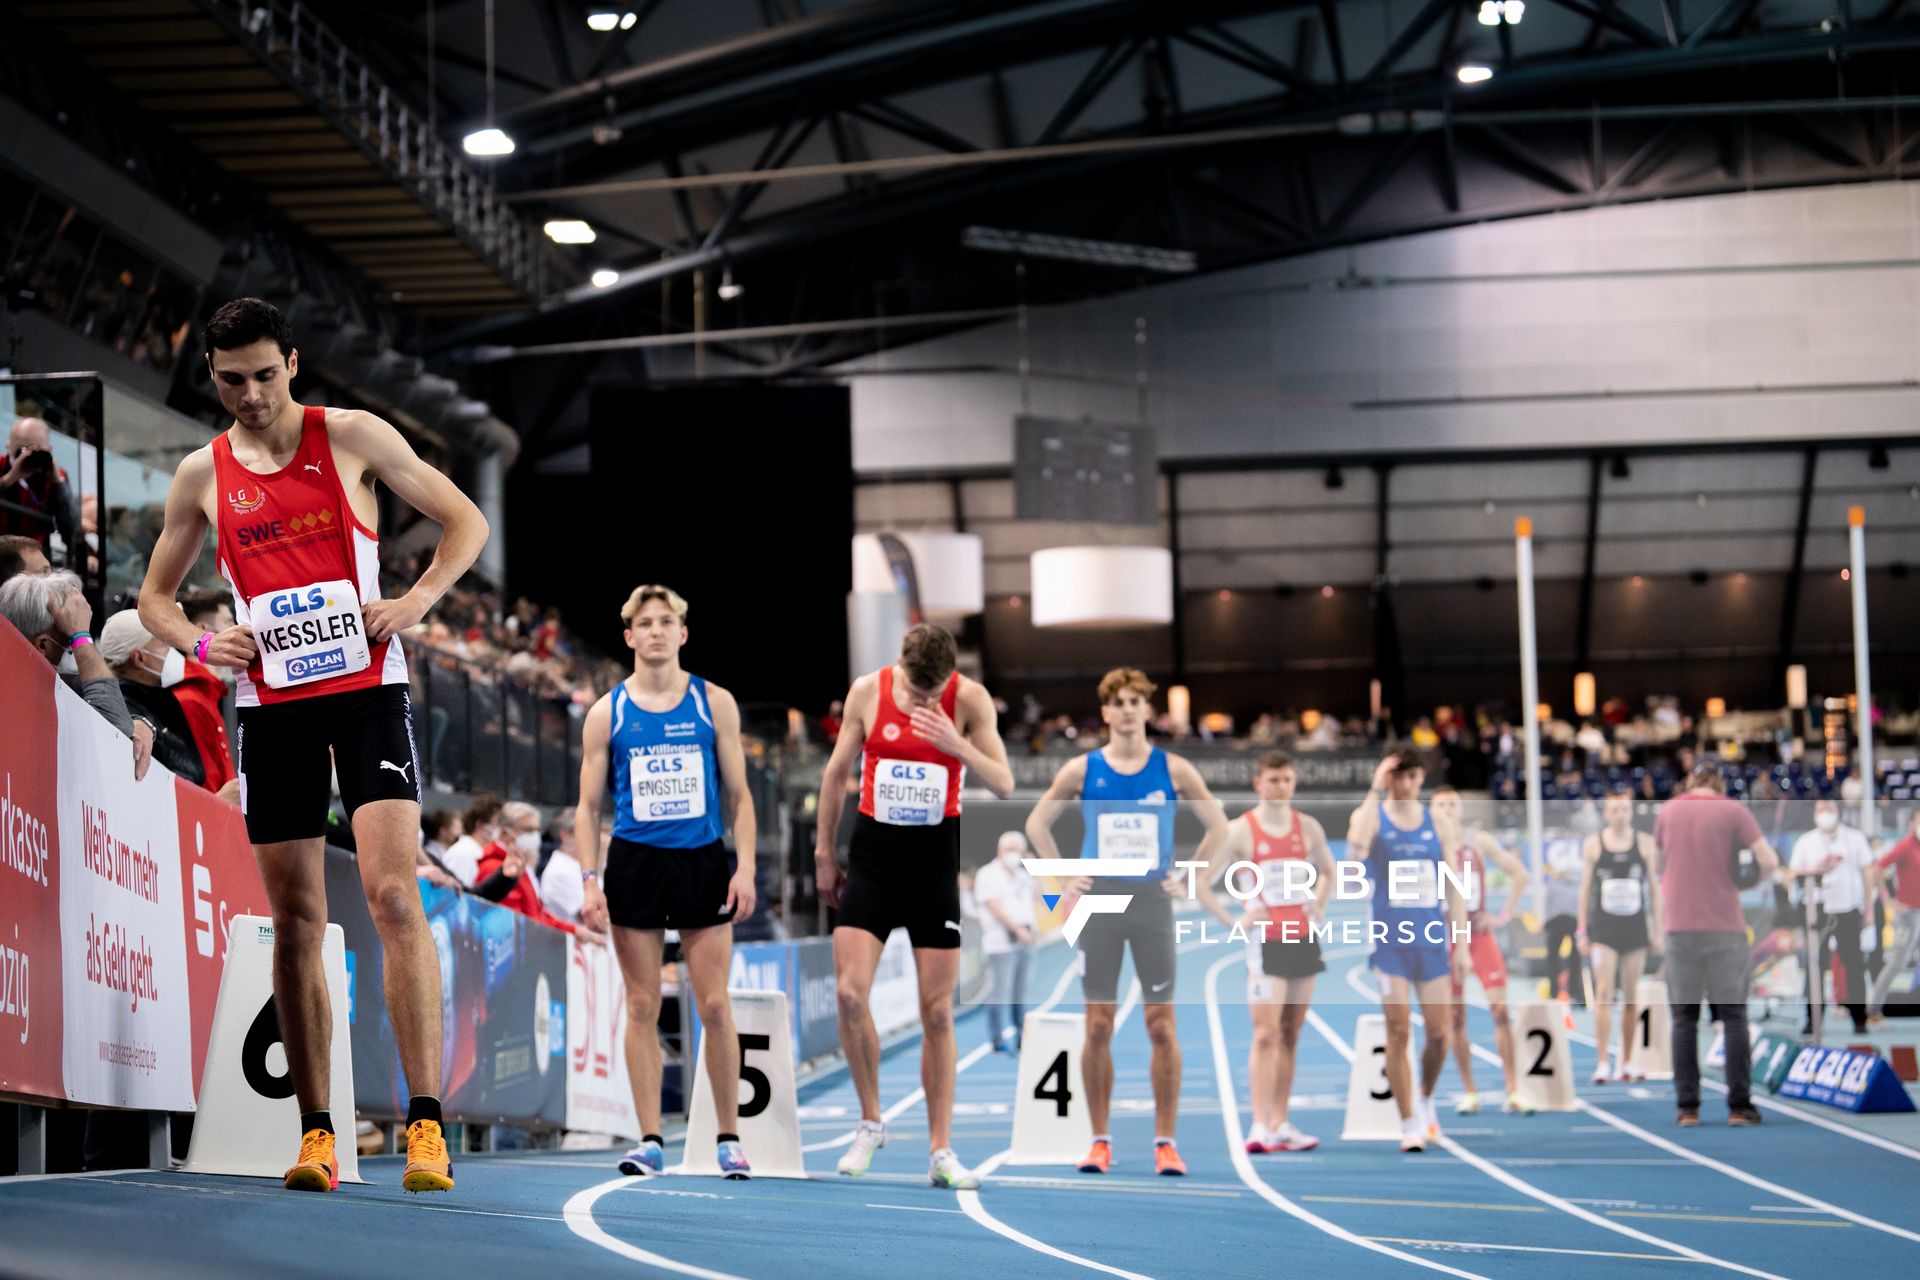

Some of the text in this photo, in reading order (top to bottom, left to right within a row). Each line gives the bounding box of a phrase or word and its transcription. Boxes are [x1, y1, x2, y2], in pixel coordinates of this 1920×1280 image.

[229, 489, 246, 503] LG
[237, 520, 285, 546] SWE
[260, 612, 359, 654] KESSLER
[308, 652, 343, 668] PLAN
[638, 777, 698, 797] ENGSTLER
[879, 783, 941, 804] REUTHER
[113, 838, 132, 892] um
[132, 839, 159, 905] mehr
[86, 912, 158, 1013] als Geld geht.
[242, 992, 297, 1100] 6
[1640, 1008, 1650, 1047] 1
[737, 1033, 771, 1118] 5
[1370, 1046, 1392, 1100] 3
[1527, 1028, 1554, 1077] 2
[1787, 1047, 1825, 1083] GLS
[1814, 1049, 1850, 1088] GLS
[1840, 1054, 1876, 1094] GLS
[1034, 1050, 1072, 1117] 4
